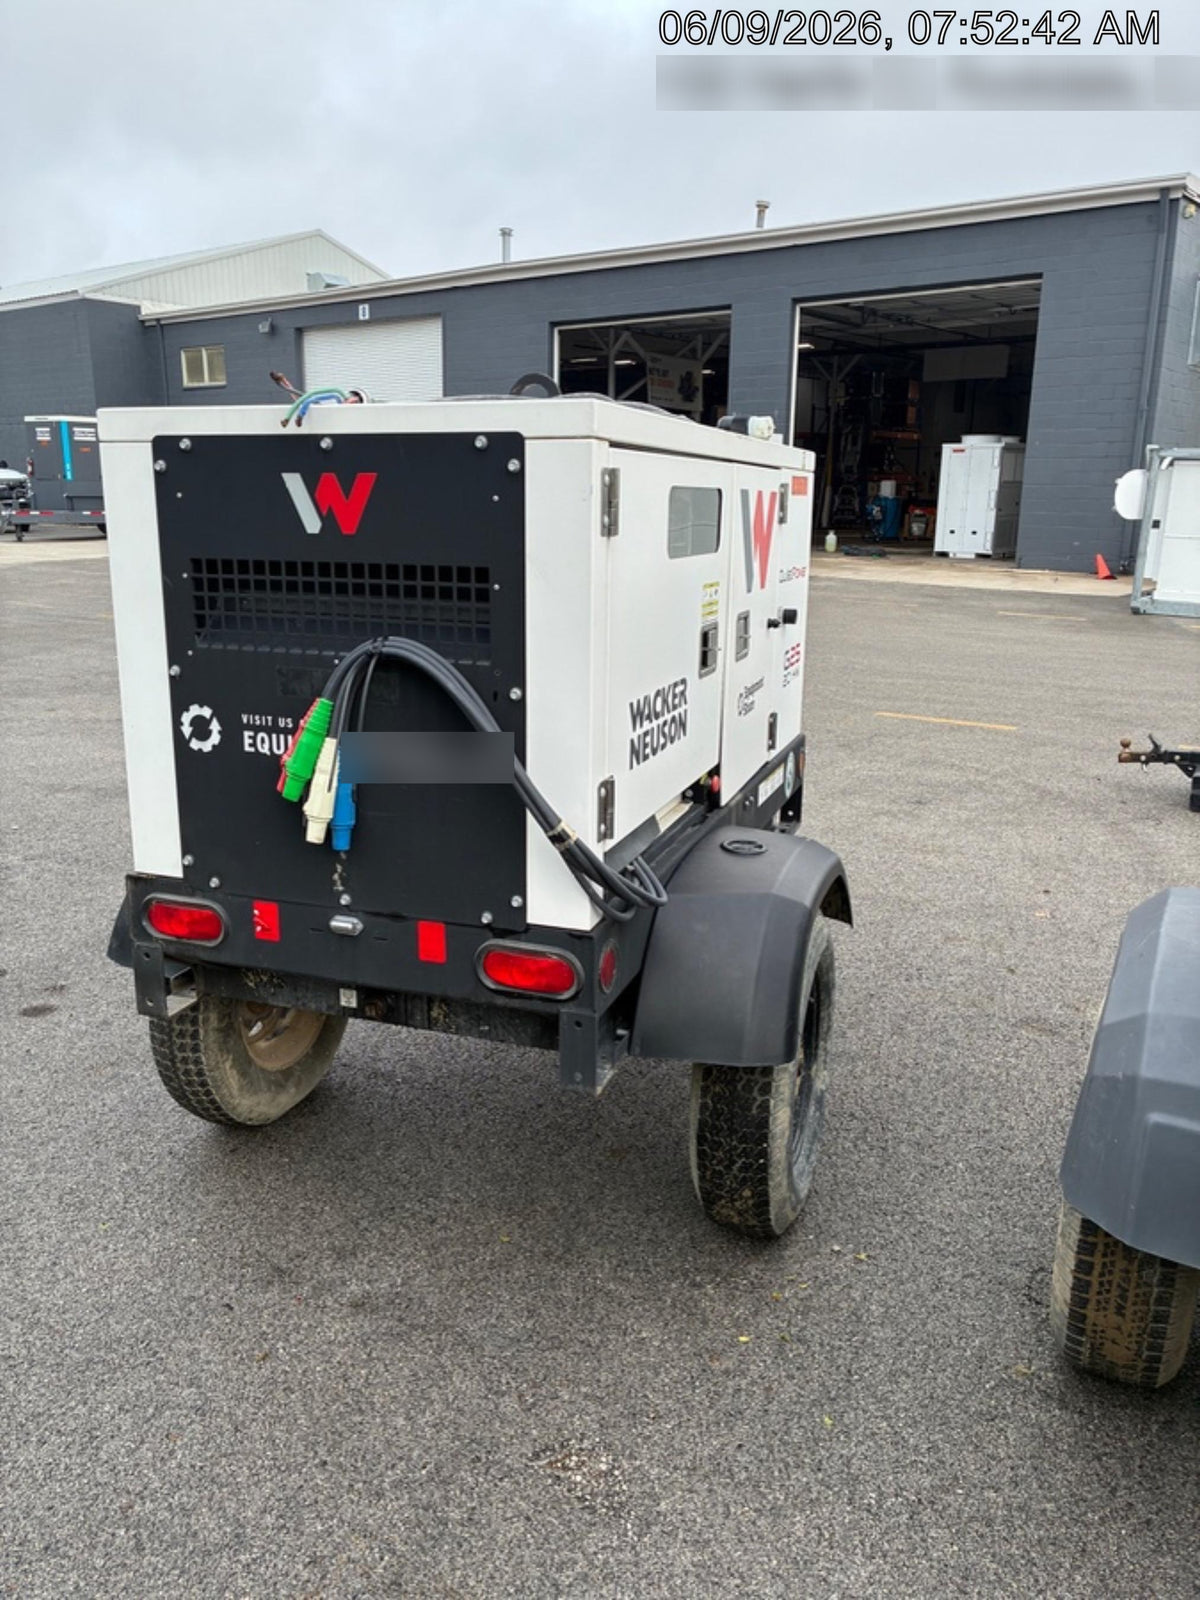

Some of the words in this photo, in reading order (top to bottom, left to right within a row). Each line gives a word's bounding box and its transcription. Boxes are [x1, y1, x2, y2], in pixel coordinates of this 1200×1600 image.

[241, 713, 273, 727] VISIT
[278, 717, 294, 729] US
[629, 677, 688, 733] WACKER
[628, 709, 688, 770] NEUSON
